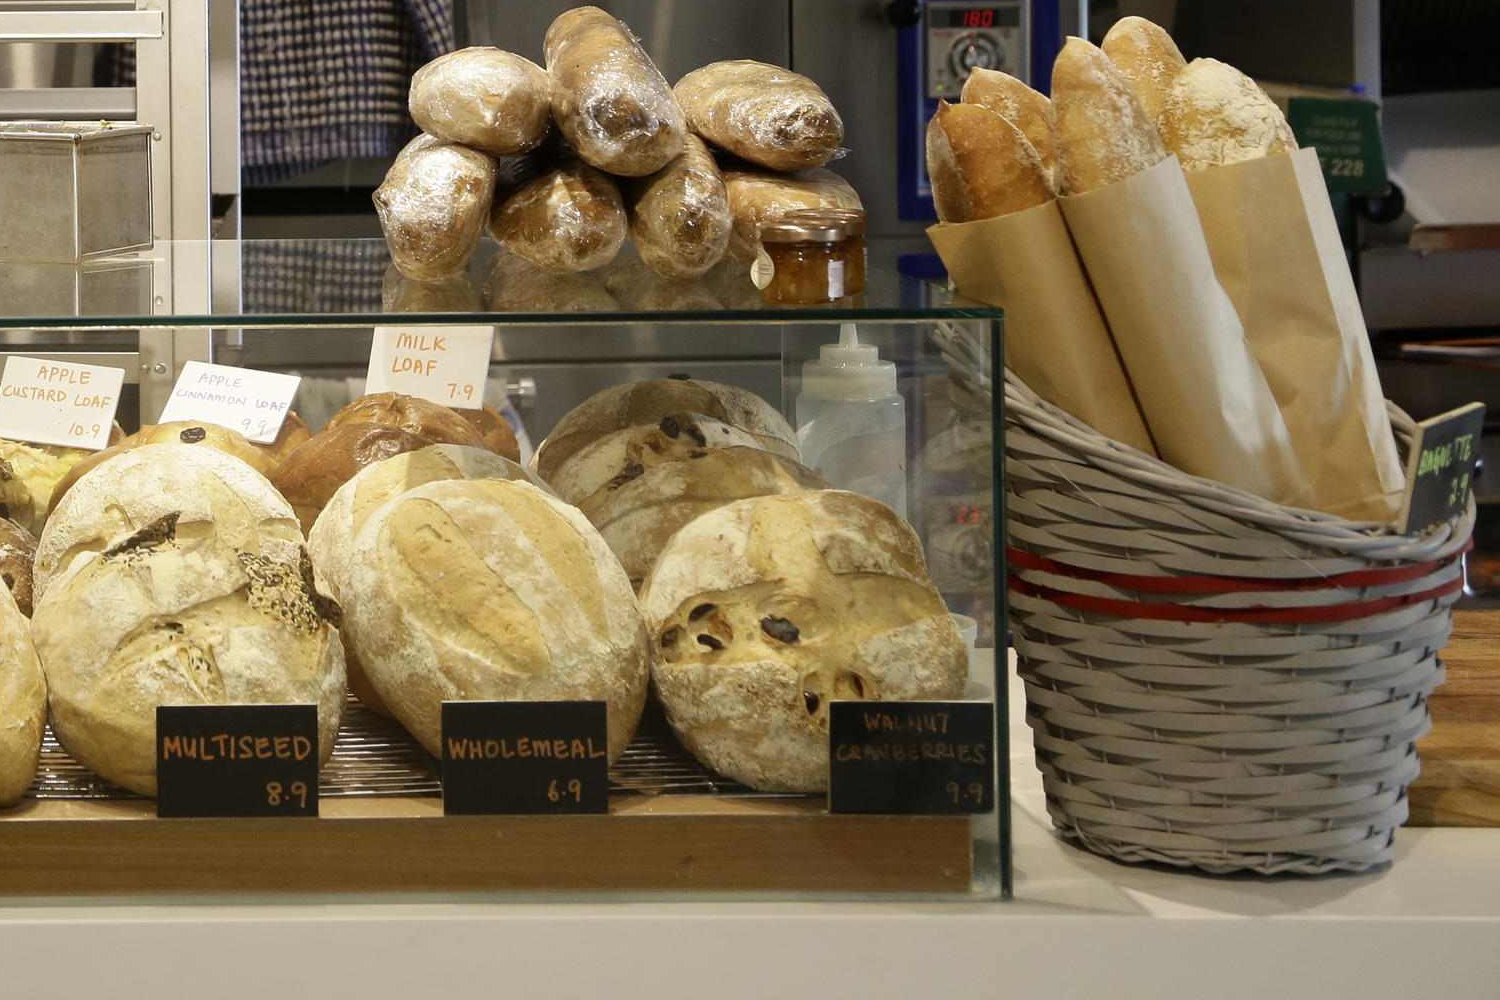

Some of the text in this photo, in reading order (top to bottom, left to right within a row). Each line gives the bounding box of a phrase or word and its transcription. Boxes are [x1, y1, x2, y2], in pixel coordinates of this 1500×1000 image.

[963, 10, 994, 27] 180
[1330, 158, 1364, 178] 228
[395, 331, 447, 352] MILK
[37, 365, 92, 386] APPLE
[391, 356, 438, 376] LOAF
[197, 371, 243, 390] APPLE
[2, 384, 111, 411] CUSTARD LOAF
[446, 382, 475, 401] 7.9
[255, 398, 289, 414] LOAF
[67, 421, 102, 440] 10.9
[240, 418, 269, 437] 9.9
[863, 712, 950, 734] WALNUT
[163, 733, 312, 762] MULTISEED
[448, 736, 606, 761] WHOLEMEAL
[836, 742, 987, 765] CRANBERRIES
[266, 781, 307, 808] 8.9
[546, 778, 582, 803] 6.9
[945, 780, 984, 805] 9.9
